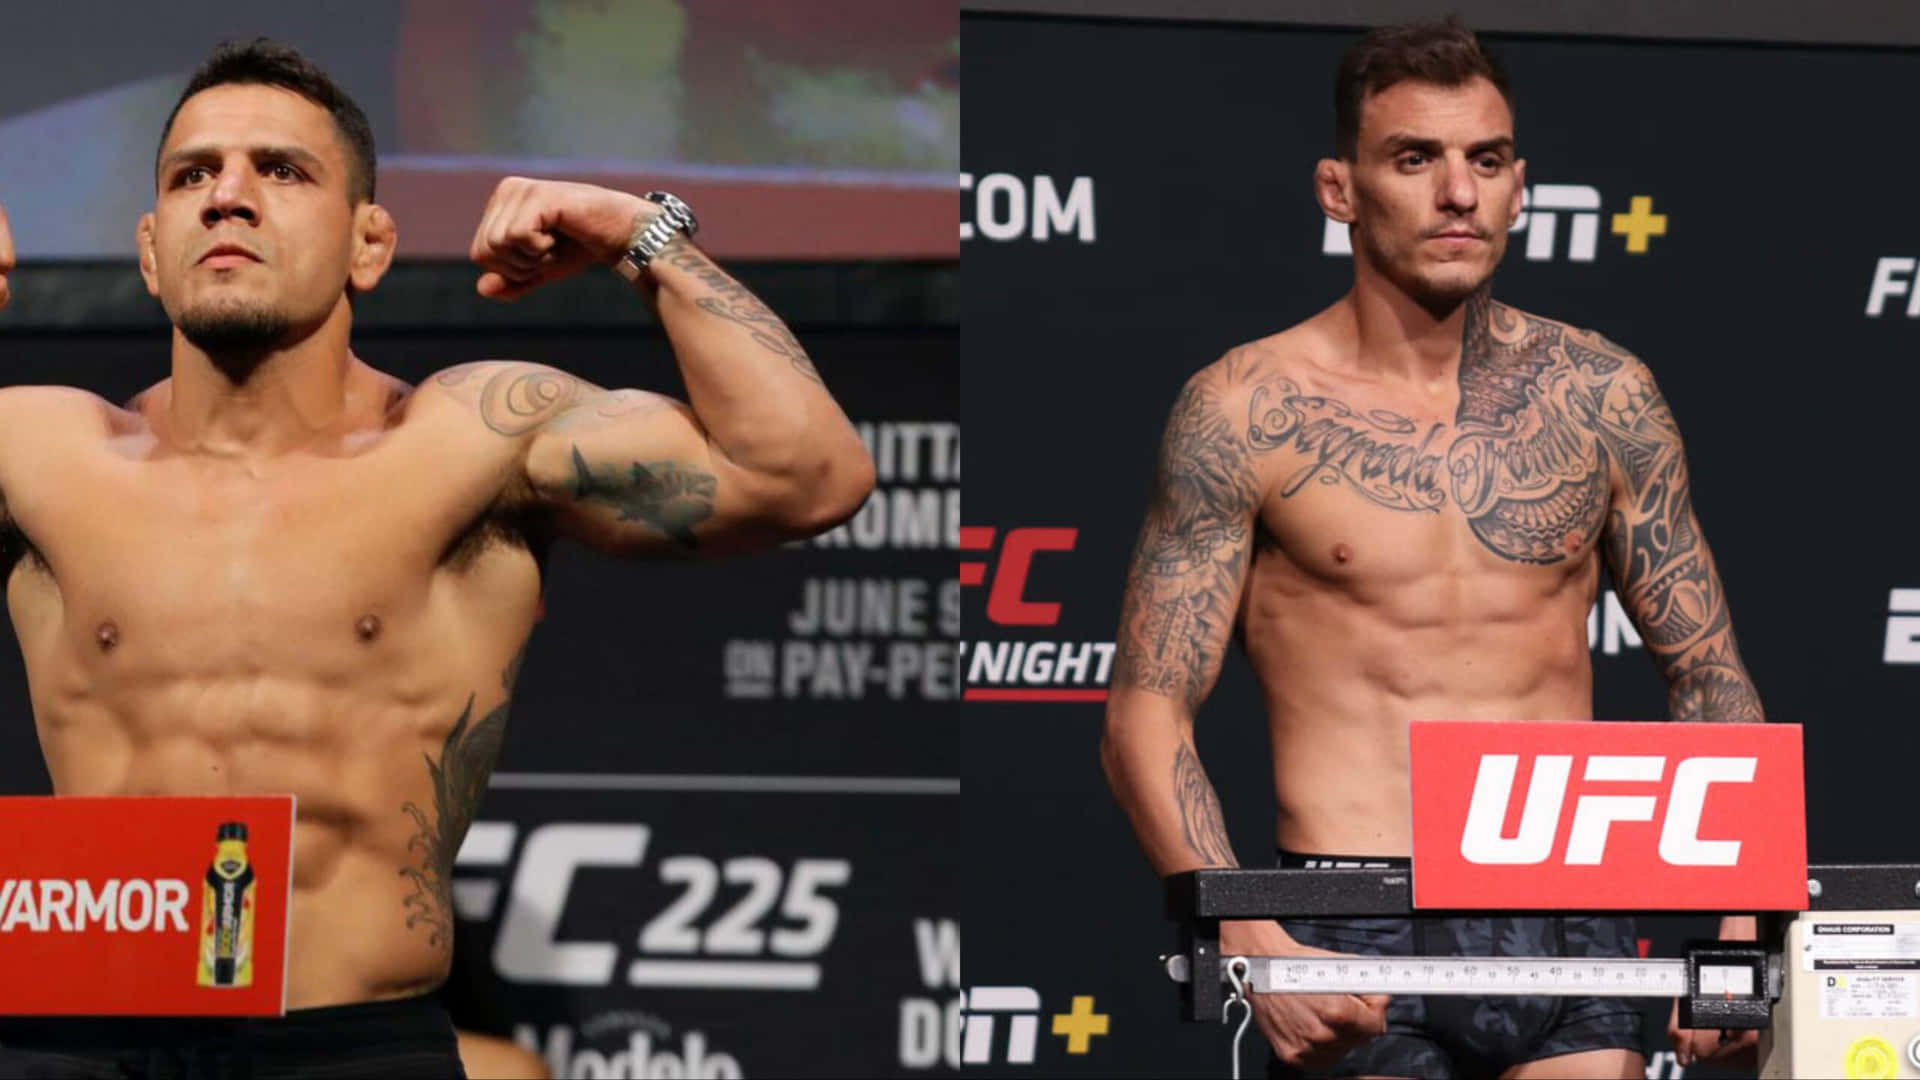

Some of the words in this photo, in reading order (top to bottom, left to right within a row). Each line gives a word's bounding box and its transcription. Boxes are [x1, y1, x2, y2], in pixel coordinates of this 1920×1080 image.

[788, 577, 928, 637] JUNE
[781, 640, 960, 700] PAY-PE
[967, 641, 1117, 685] NIGHT
[1460, 753, 1758, 867] UFC
[636, 855, 853, 957] 225
